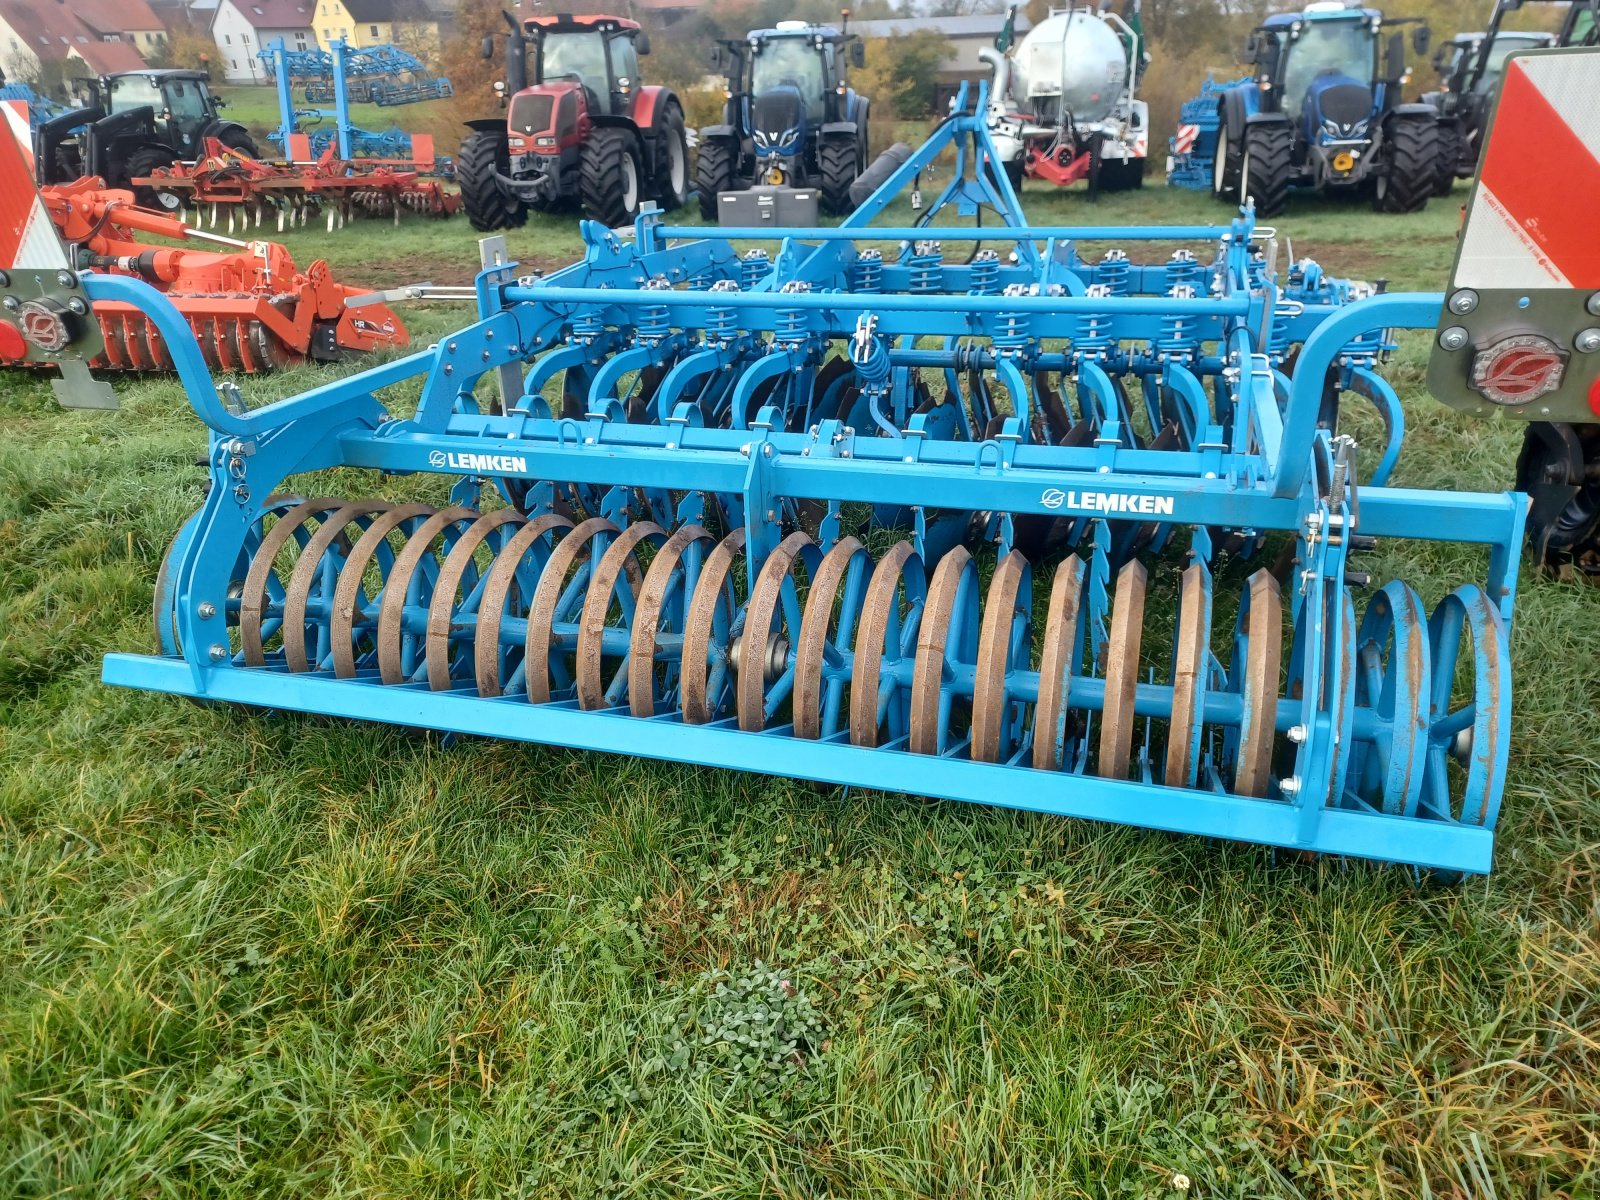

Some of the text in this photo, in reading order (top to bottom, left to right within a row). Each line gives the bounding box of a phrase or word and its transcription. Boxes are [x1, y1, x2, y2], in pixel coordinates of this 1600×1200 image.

[354, 319, 366, 329] HR
[447, 452, 527, 473] LEMKEN
[1067, 490, 1174, 515] LEMKEN
